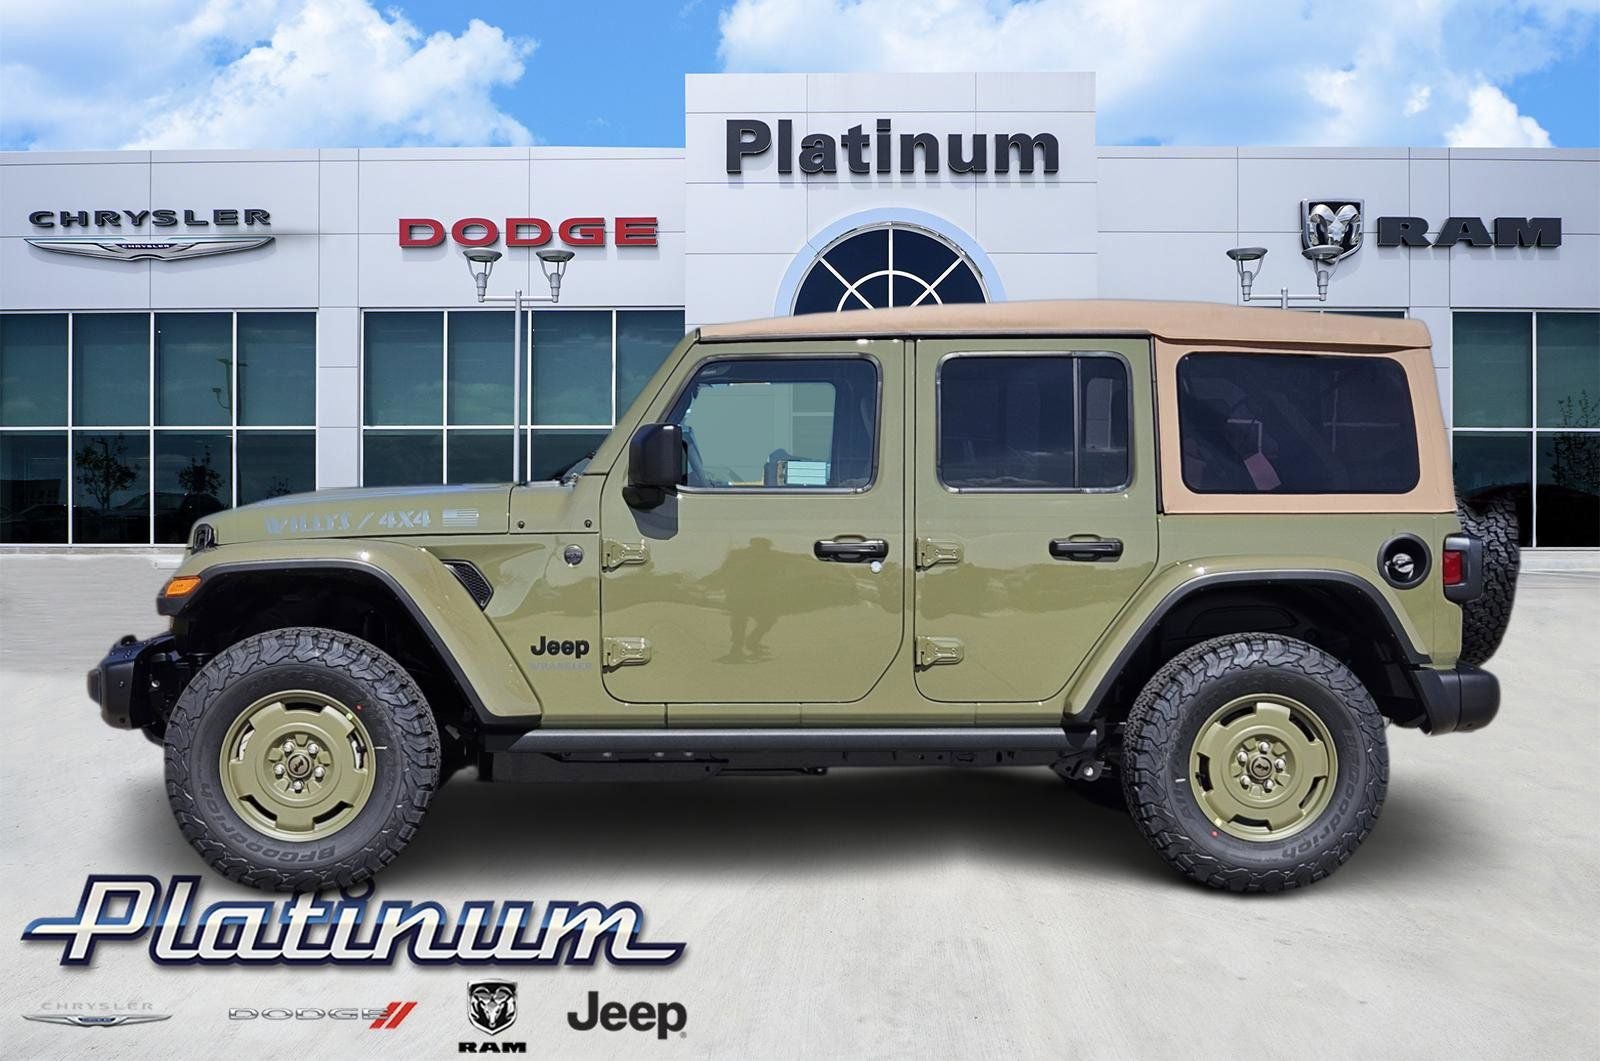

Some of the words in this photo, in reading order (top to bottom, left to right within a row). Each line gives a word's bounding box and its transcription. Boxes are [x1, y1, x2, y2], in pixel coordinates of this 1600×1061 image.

[726, 119, 1060, 175] Platinum
[29, 209, 271, 228] CHRYSLER
[398, 217, 658, 248] DODGE
[1377, 216, 1562, 248] RAM
[530, 635, 590, 659] Jeep
